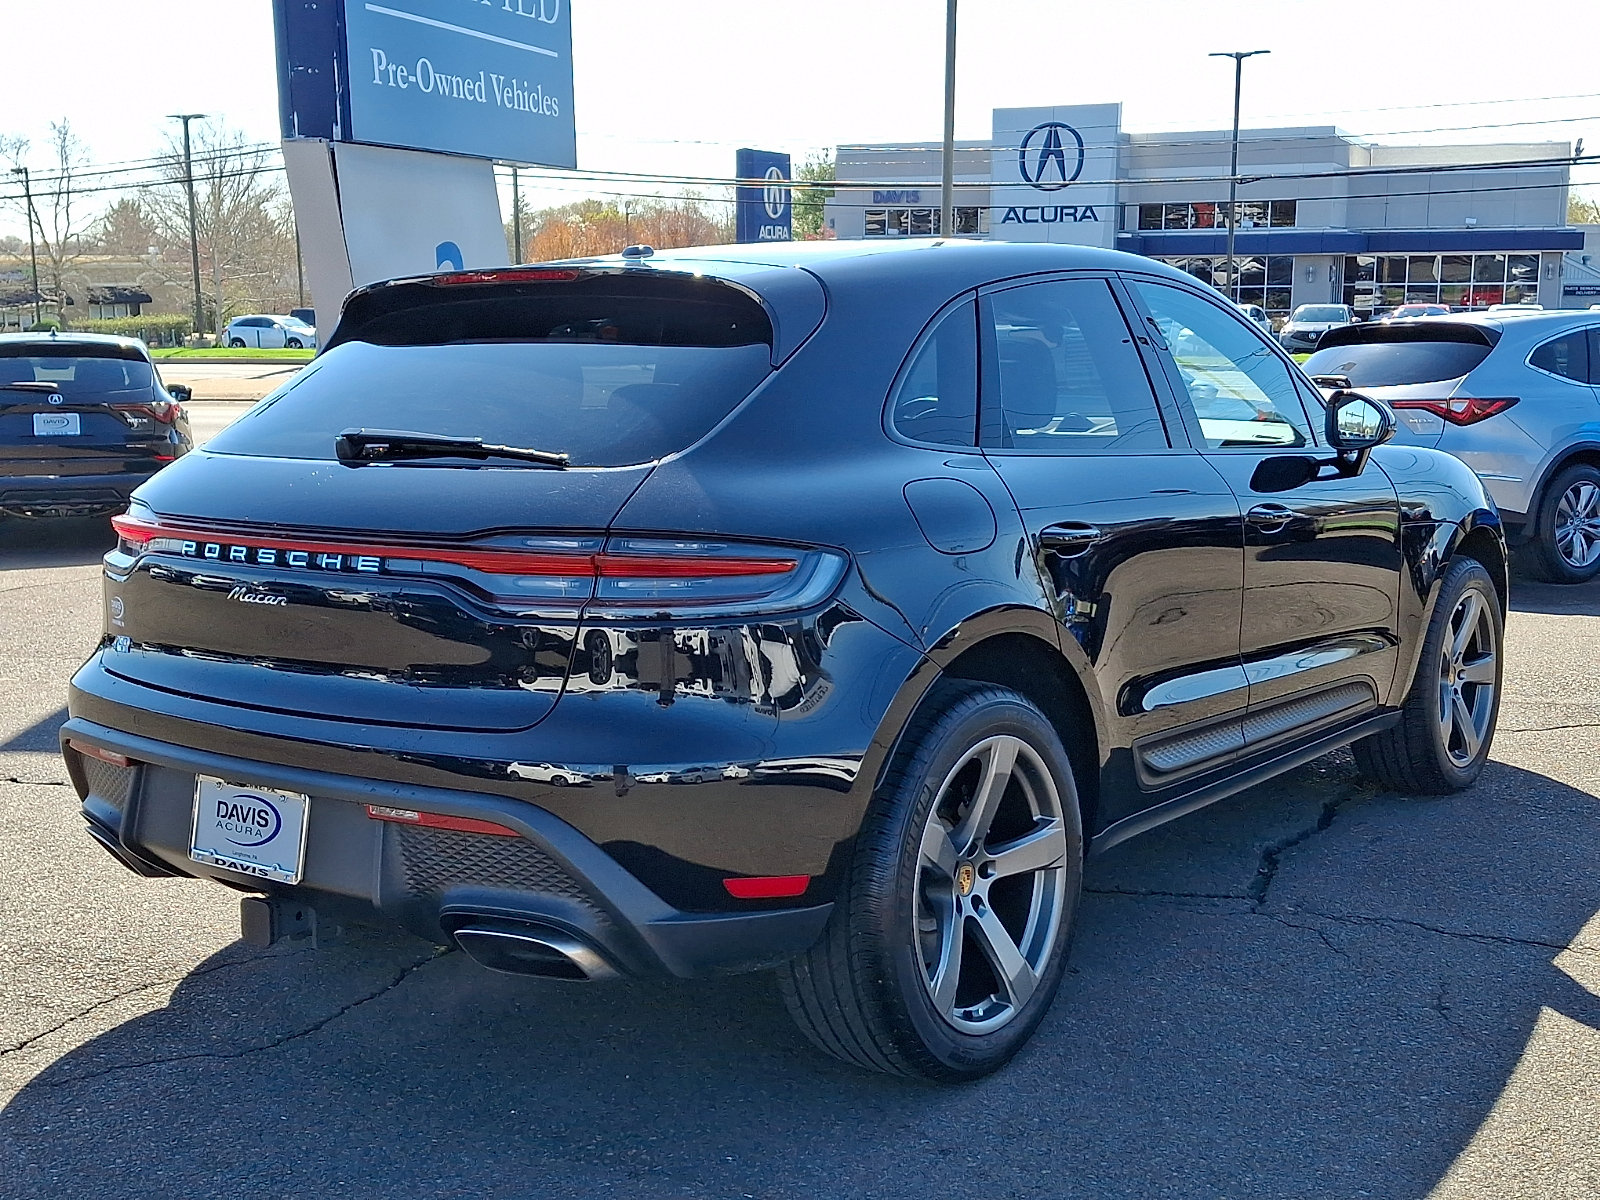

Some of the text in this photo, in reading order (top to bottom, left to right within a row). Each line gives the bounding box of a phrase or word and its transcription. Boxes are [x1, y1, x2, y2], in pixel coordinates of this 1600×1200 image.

[370, 48, 559, 117] Pre-Owned Vehicles
[873, 190, 920, 204] DAVIS
[1001, 205, 1099, 224] ACURA
[759, 225, 789, 239] ACURA
[182, 541, 380, 572] PORSCHE
[227, 586, 287, 606] Macan
[216, 800, 270, 828] DAVIS
[216, 820, 263, 838] ACURA
[214, 858, 269, 877] DAVIS
